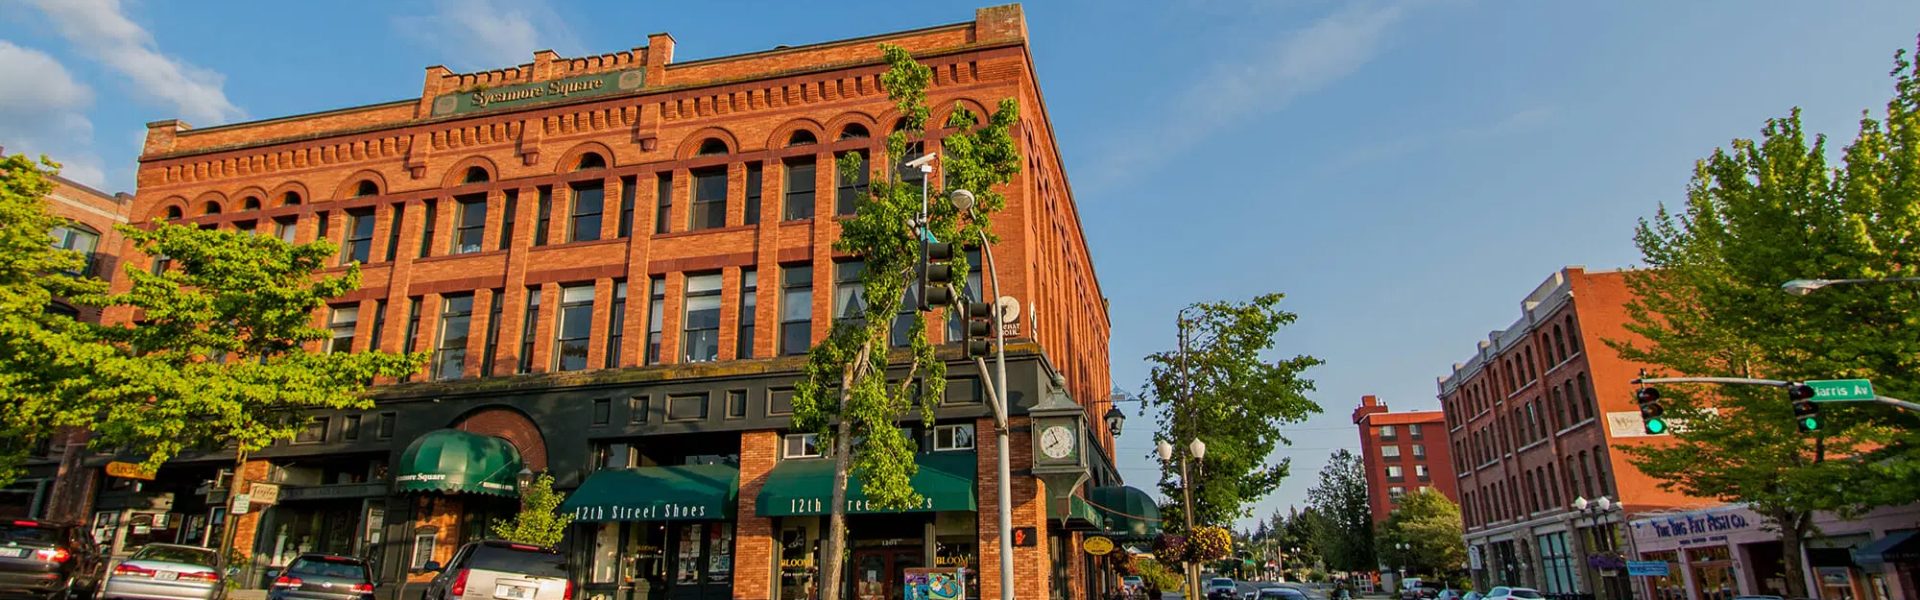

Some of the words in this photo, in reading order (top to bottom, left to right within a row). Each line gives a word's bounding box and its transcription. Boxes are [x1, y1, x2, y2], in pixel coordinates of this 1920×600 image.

[472, 87, 543, 107] Sycamore
[547, 80, 603, 96] Square
[1854, 384, 1868, 396] Av
[417, 473, 446, 482] Square
[575, 506, 604, 520] 12th
[611, 505, 656, 519] Street
[664, 503, 706, 518] Shoes
[791, 498, 821, 513] 12th
